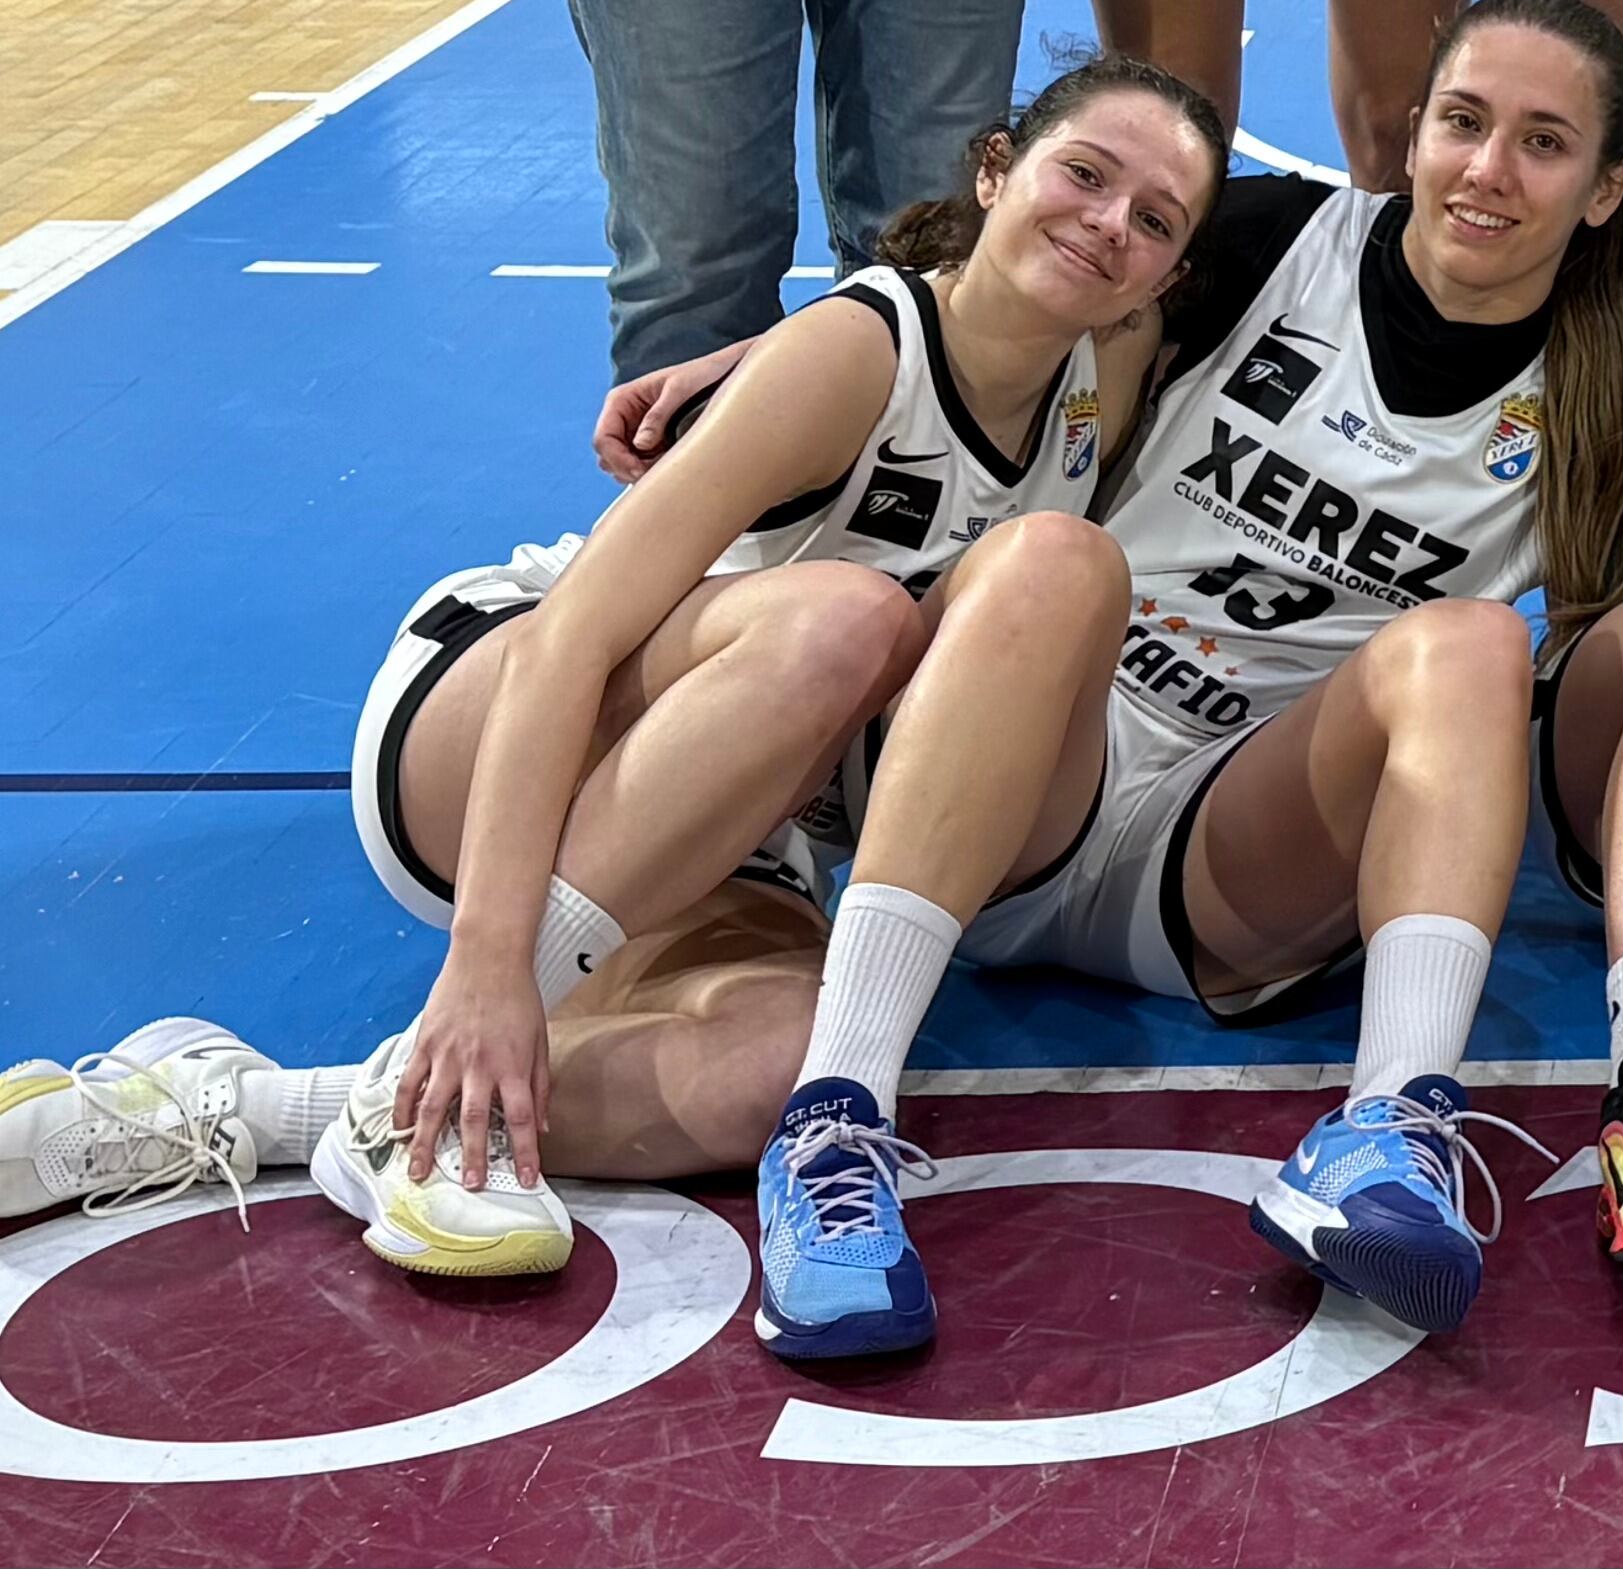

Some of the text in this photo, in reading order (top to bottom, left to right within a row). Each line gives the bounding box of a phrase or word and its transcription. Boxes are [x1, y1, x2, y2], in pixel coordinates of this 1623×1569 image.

[1174, 481, 1214, 511] CLUB
[1214, 504, 1306, 564] DEPORTIVO
[1180, 416, 1470, 601] XEREZ
[810, 1098, 853, 1116] CUT
